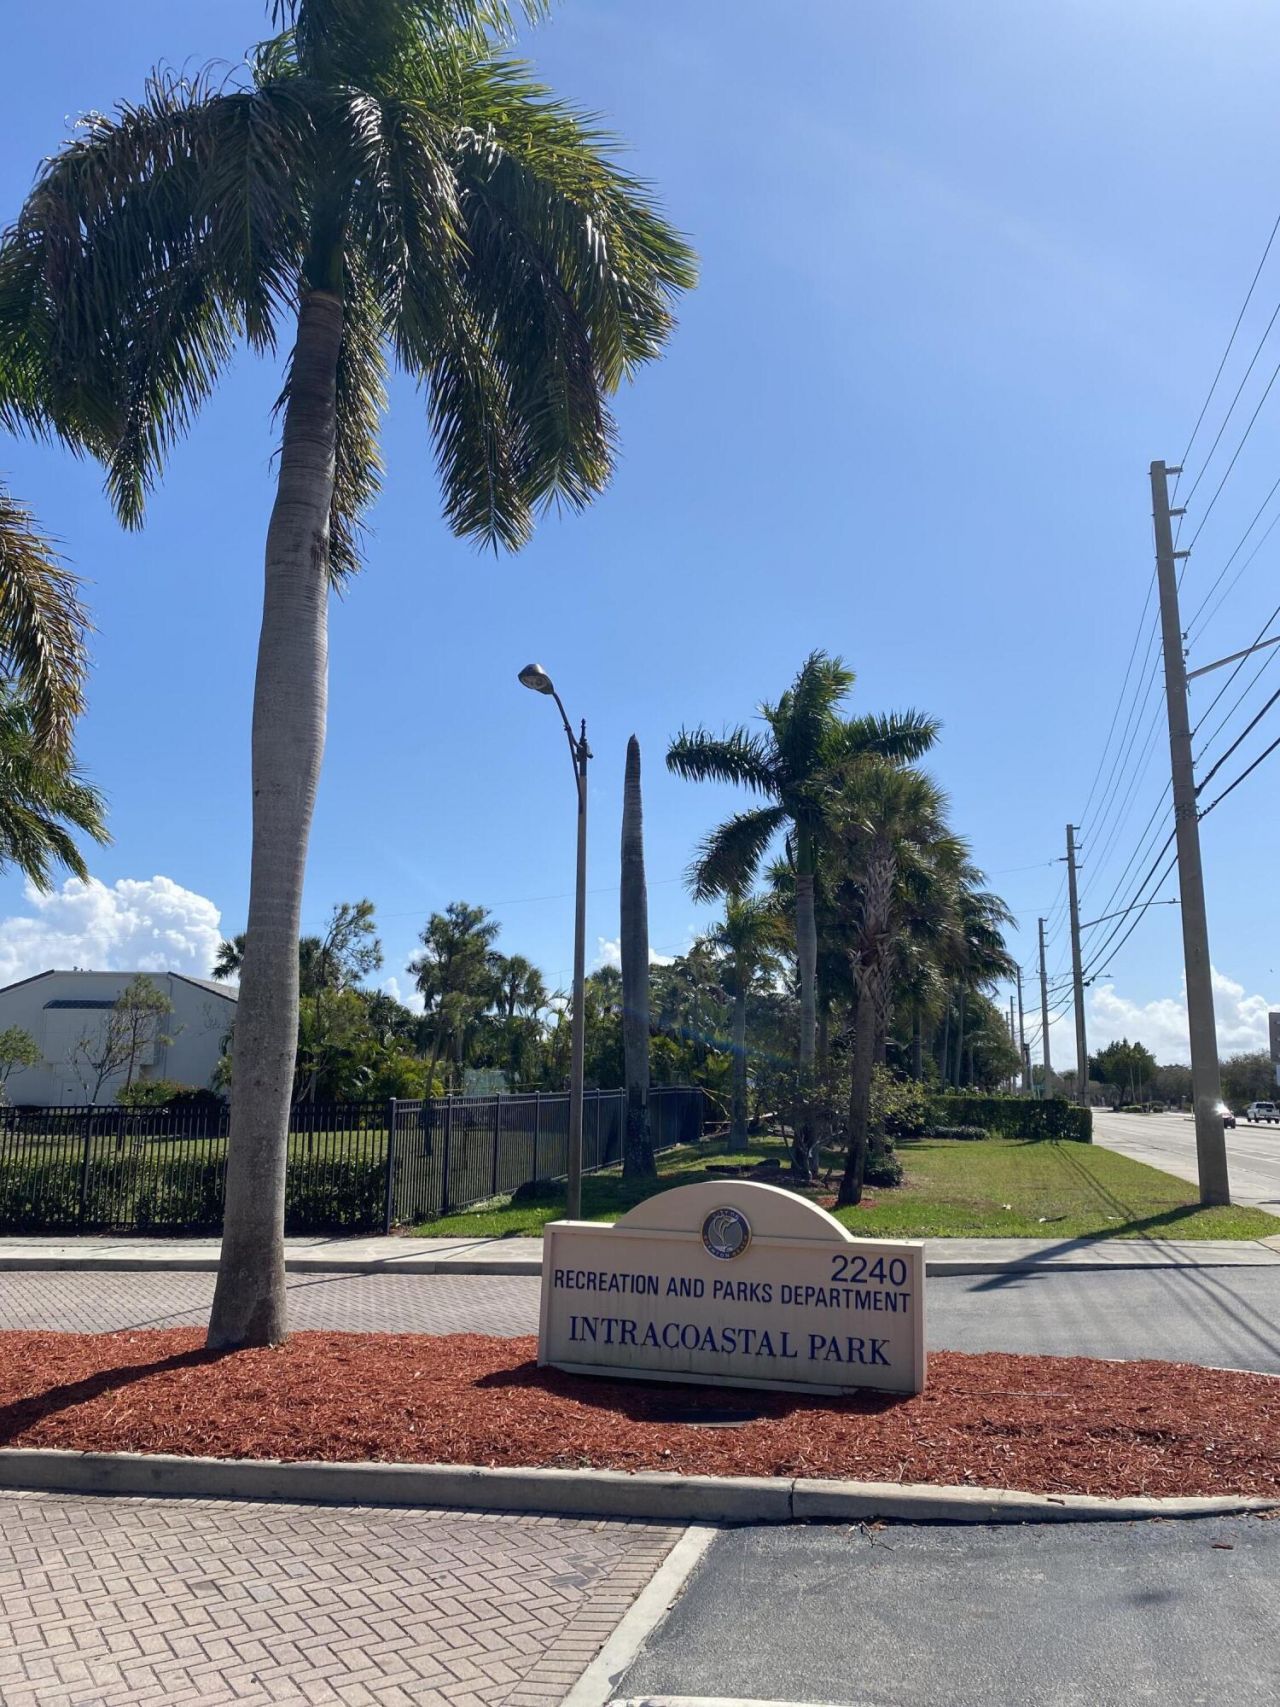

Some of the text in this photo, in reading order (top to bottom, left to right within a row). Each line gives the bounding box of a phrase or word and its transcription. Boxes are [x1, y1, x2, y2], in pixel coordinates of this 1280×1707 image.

[554, 1269, 911, 1313] RECREATION AND PARKS DEPARTMENT
[831, 1254, 907, 1287] 2240
[569, 1315, 892, 1366] INTRACOASTAL PARK
